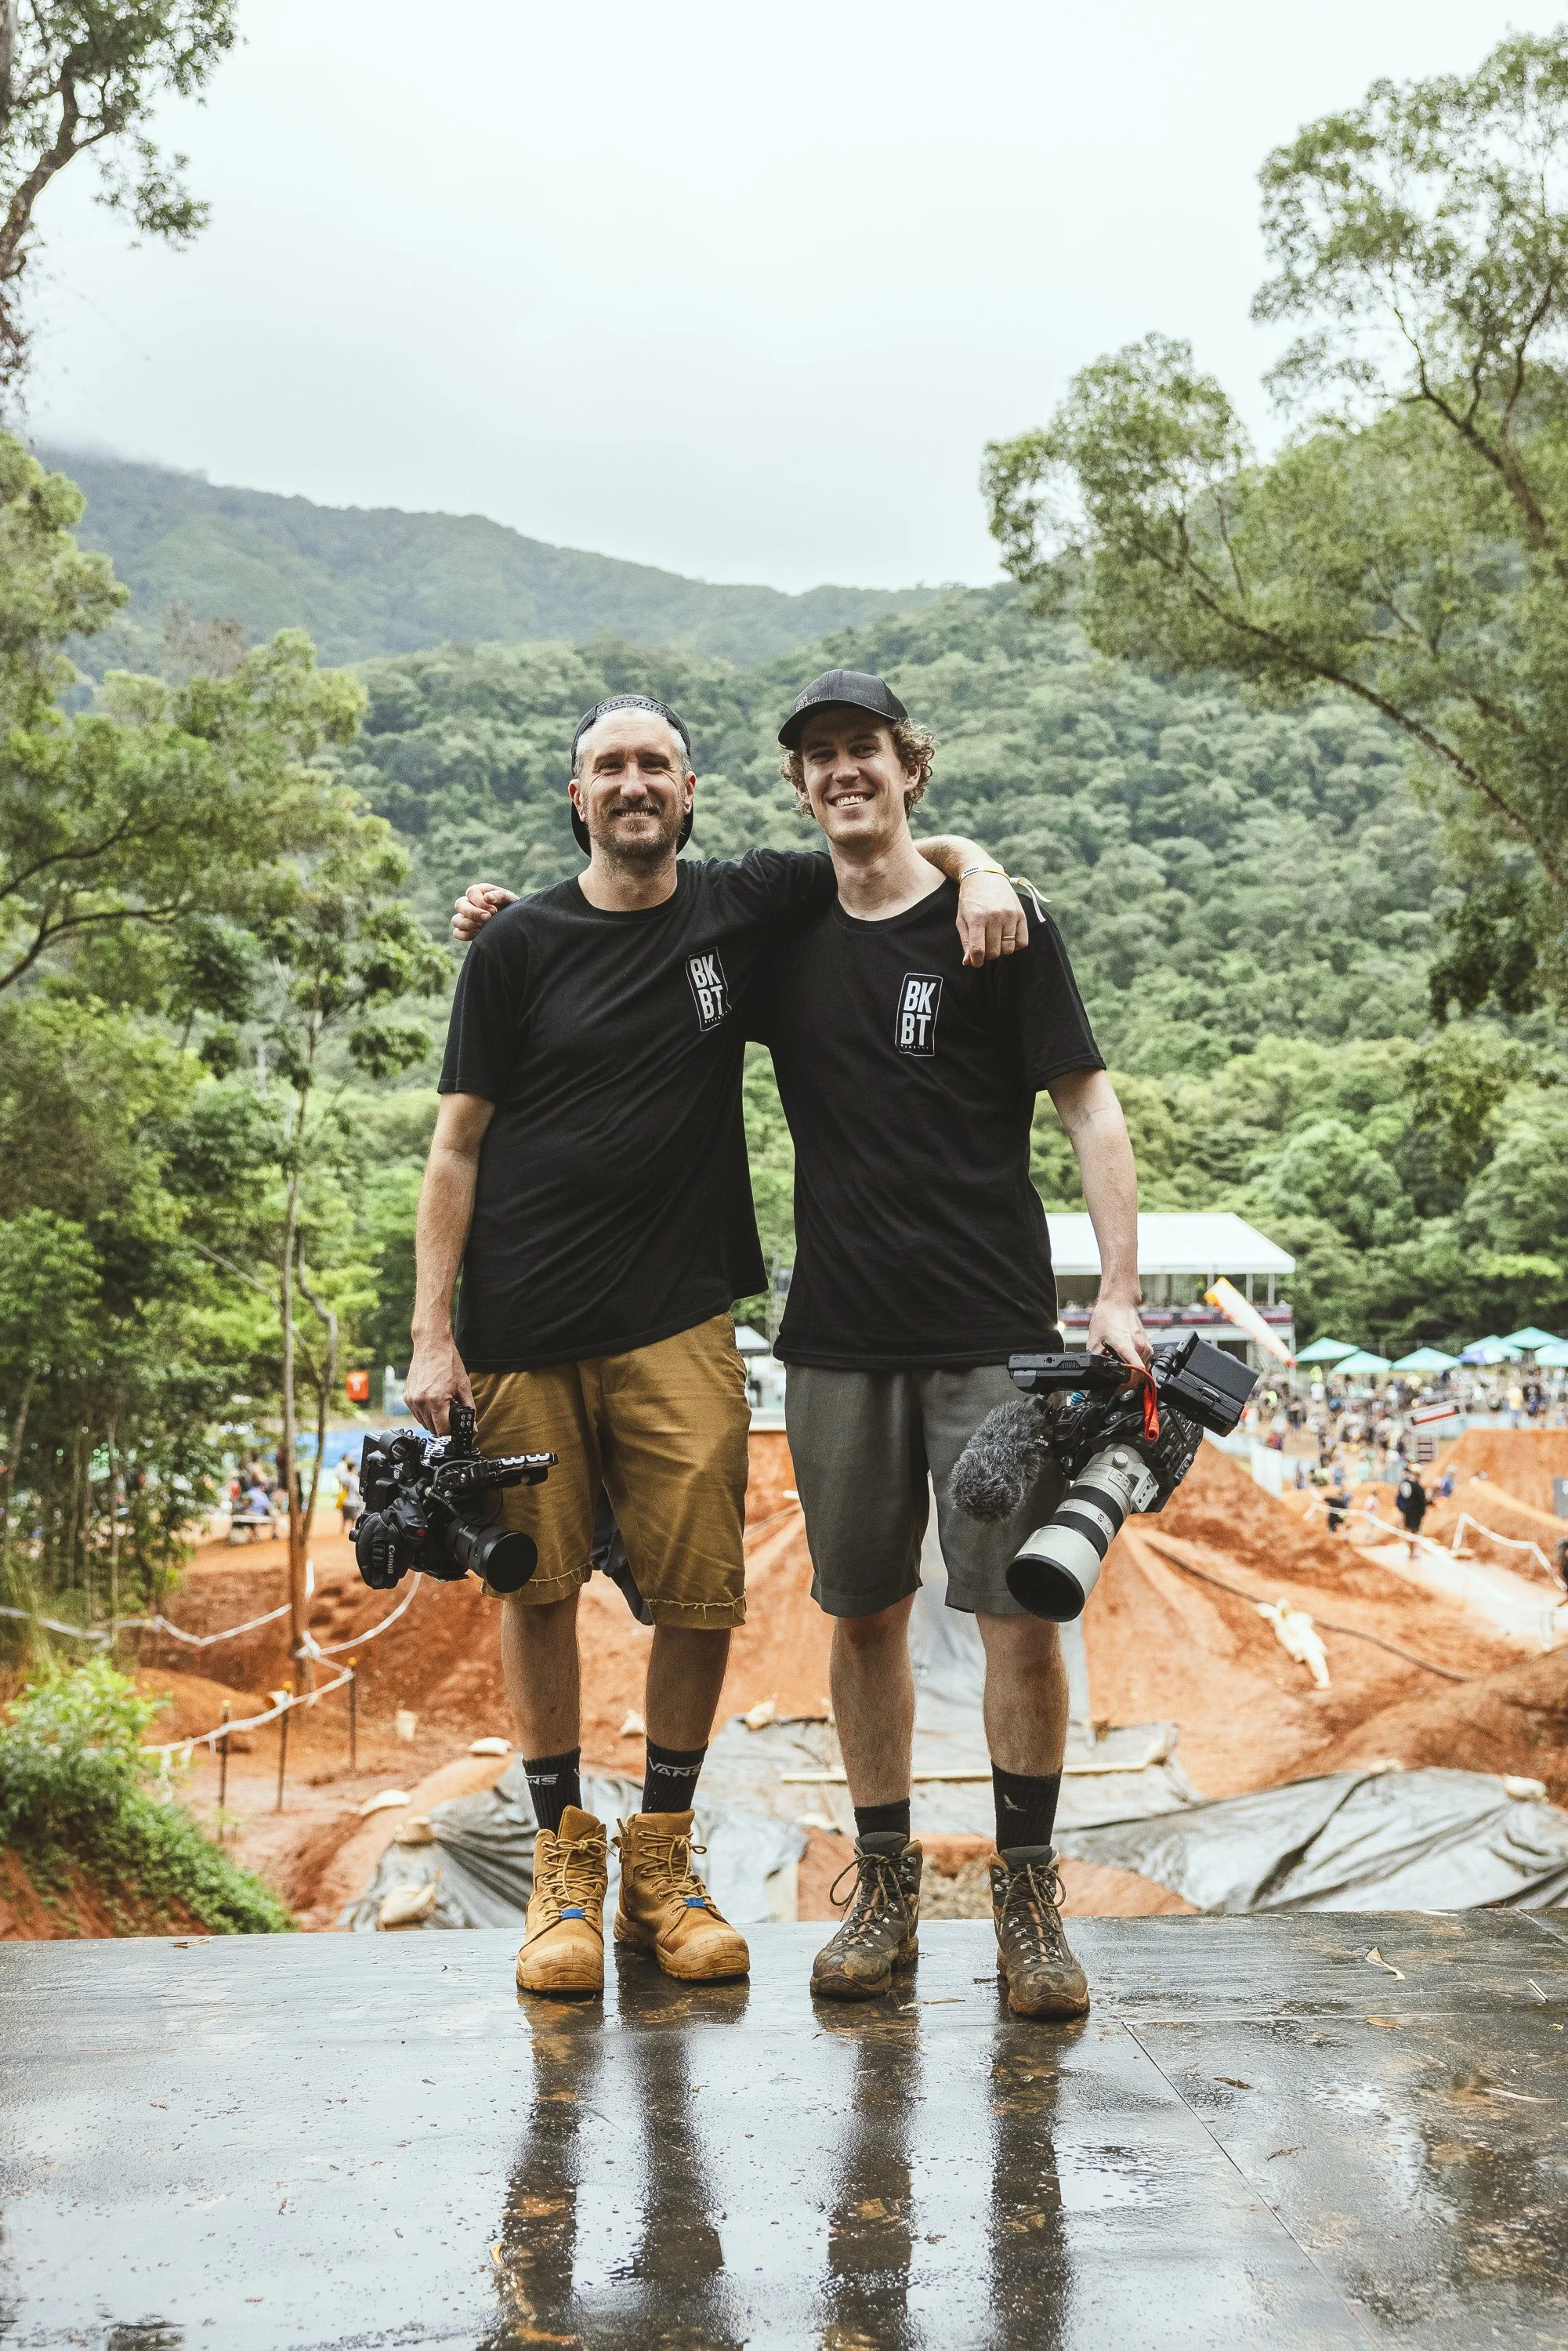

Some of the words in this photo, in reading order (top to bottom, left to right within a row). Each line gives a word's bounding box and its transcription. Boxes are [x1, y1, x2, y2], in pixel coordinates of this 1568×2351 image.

[690, 954, 722, 988] BK
[697, 984, 723, 1020] BT
[903, 980, 936, 1014] BK
[900, 1012, 932, 1046] BT
[387, 1544, 396, 1574] Canon
[648, 1757, 703, 1777] VANS
